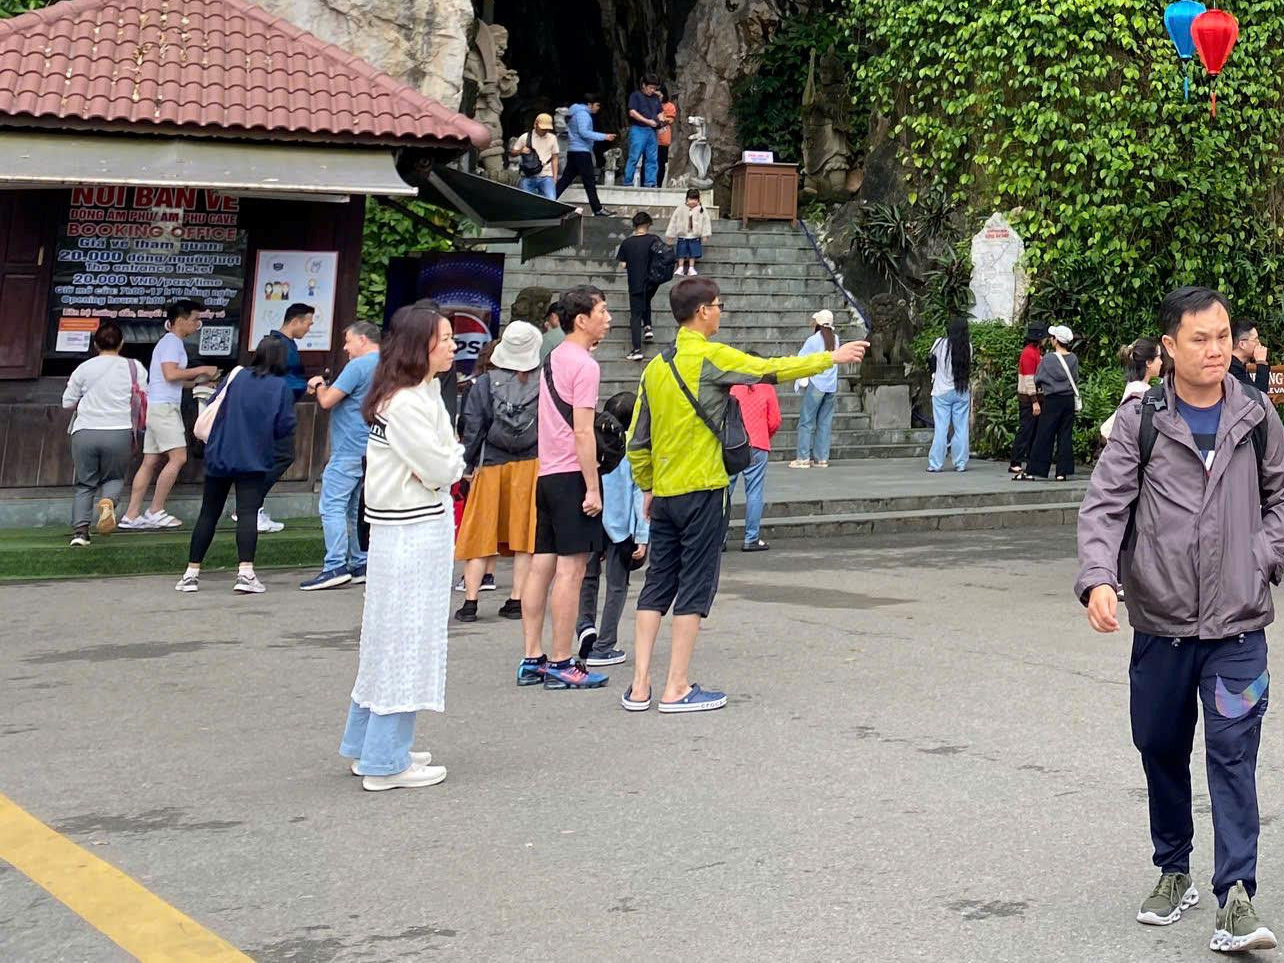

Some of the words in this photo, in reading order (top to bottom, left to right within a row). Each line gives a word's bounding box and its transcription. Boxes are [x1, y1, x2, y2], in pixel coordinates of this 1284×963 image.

[67, 222, 164, 238] BOOKING
[170, 225, 237, 241] OFFICE
[58, 250, 123, 262] 20.000
[85, 261, 110, 272] The
[112, 263, 174, 274] entrance
[175, 264, 214, 274] ticket
[72, 274, 127, 285] 20.000
